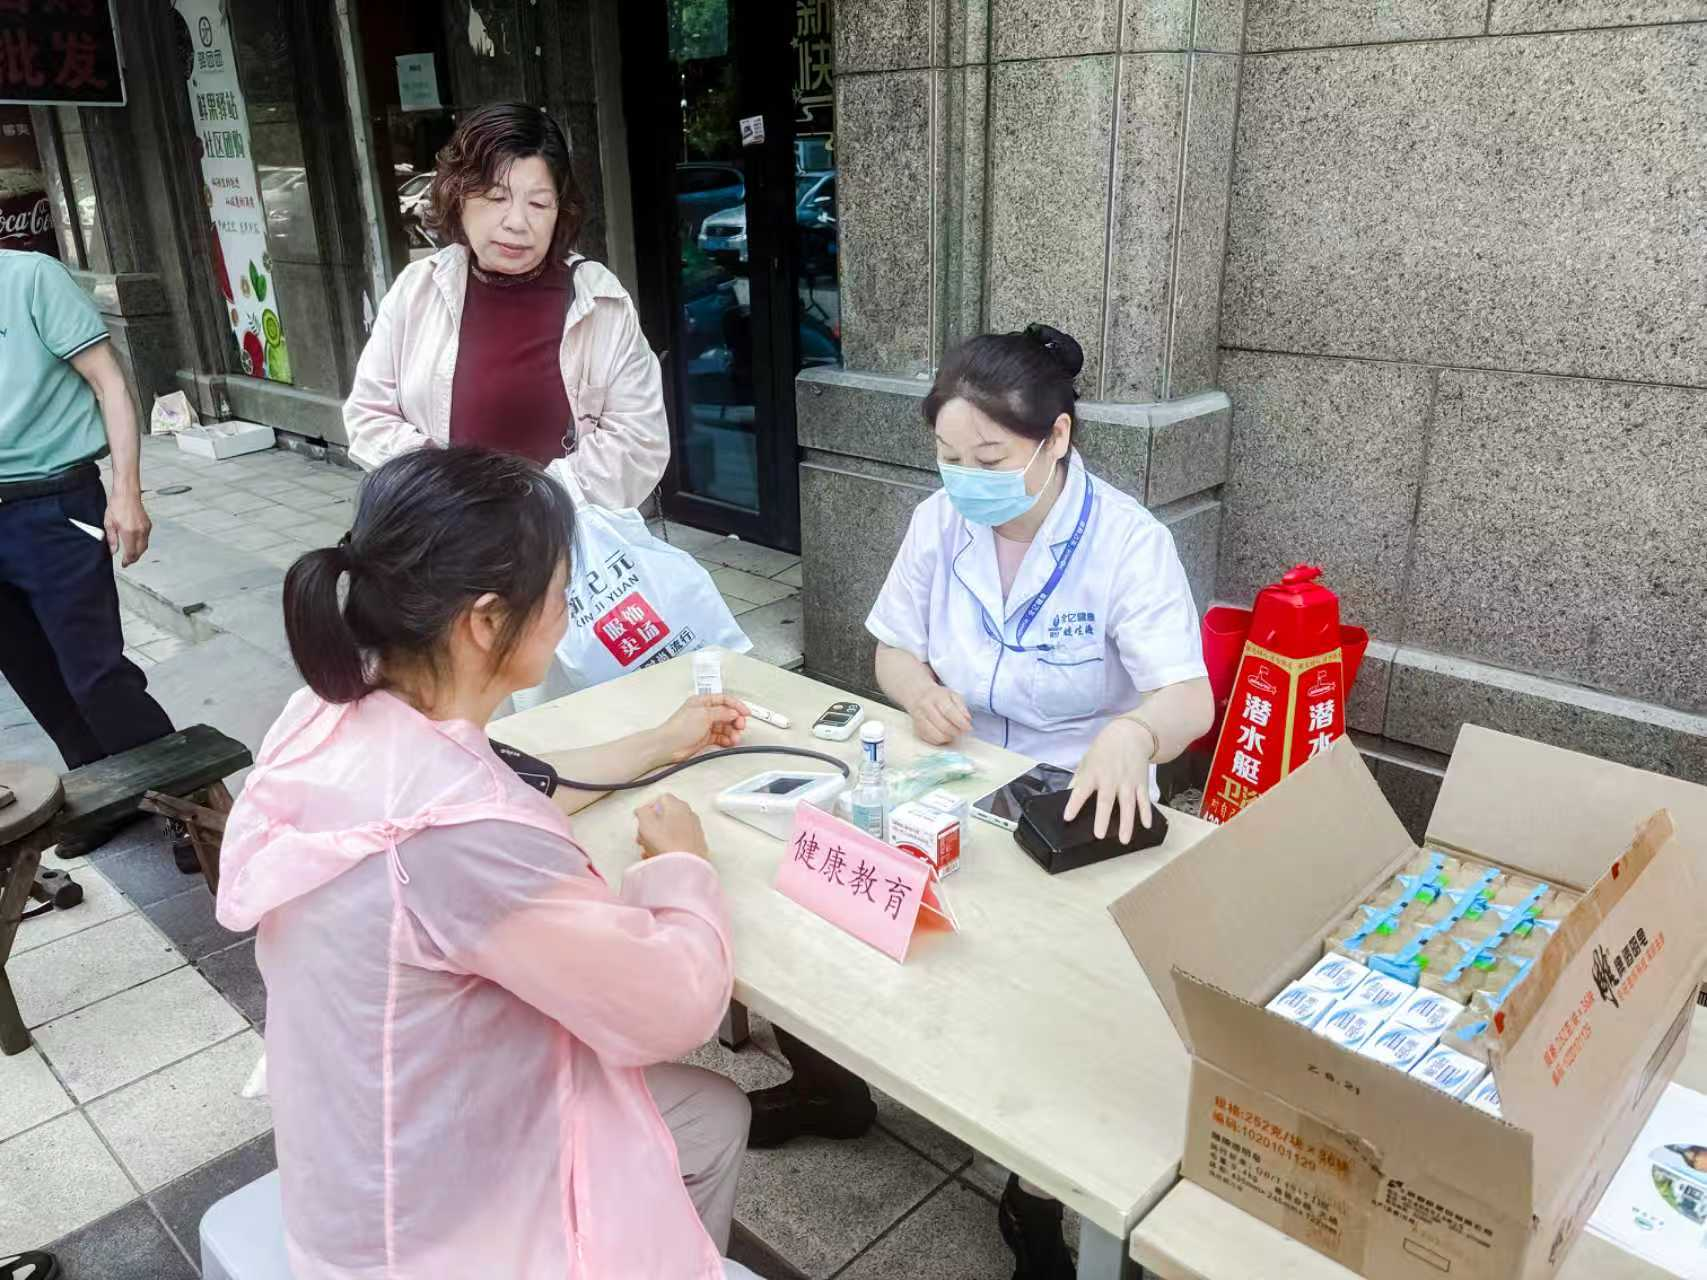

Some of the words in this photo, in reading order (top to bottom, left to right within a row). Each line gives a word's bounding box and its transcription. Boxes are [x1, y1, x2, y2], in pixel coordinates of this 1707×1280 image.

[202, 129, 245, 159] 社区团购
[608, 573, 640, 602] YUAN
[1231, 692, 1272, 785] 潜水艇
[793, 830, 914, 921] 健康教育
